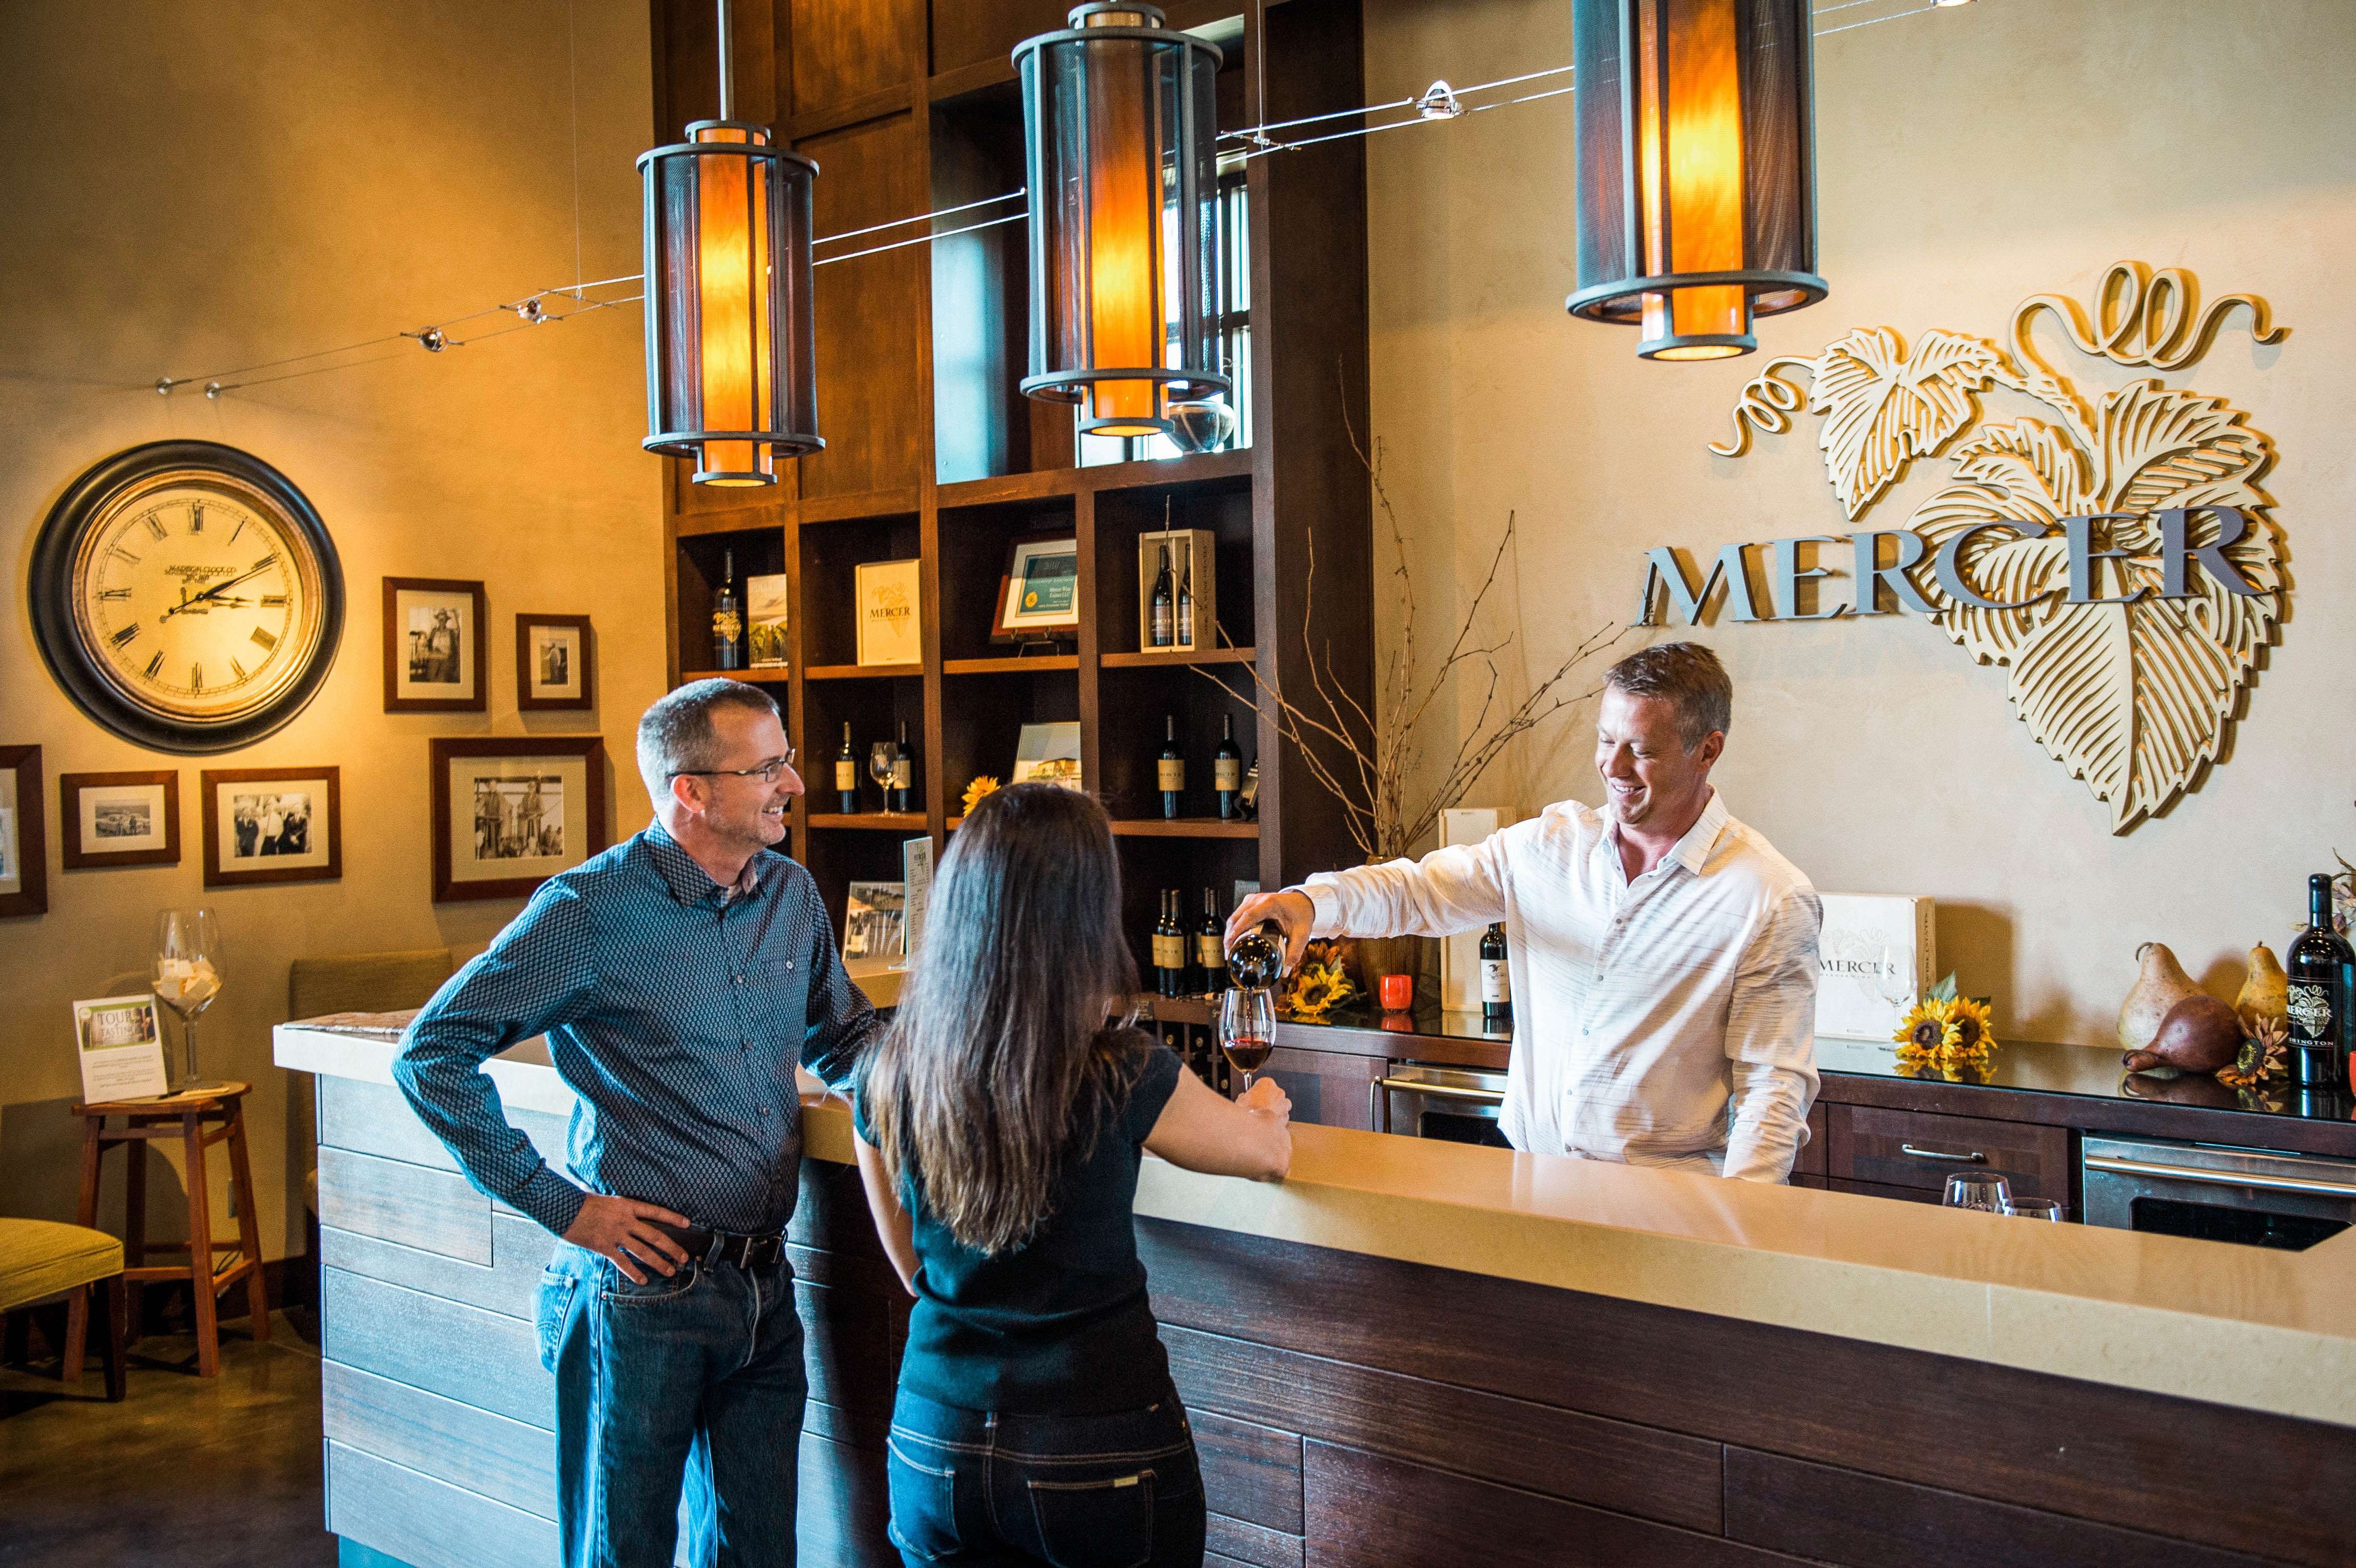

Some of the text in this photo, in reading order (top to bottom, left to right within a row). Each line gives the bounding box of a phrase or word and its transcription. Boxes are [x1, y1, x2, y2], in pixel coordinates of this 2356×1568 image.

[1631, 505, 2272, 627] MERCER
[870, 607, 911, 618] MERCER
[1820, 959, 1896, 975] MERCER
[2288, 1037, 2334, 1046] SHINGTON
